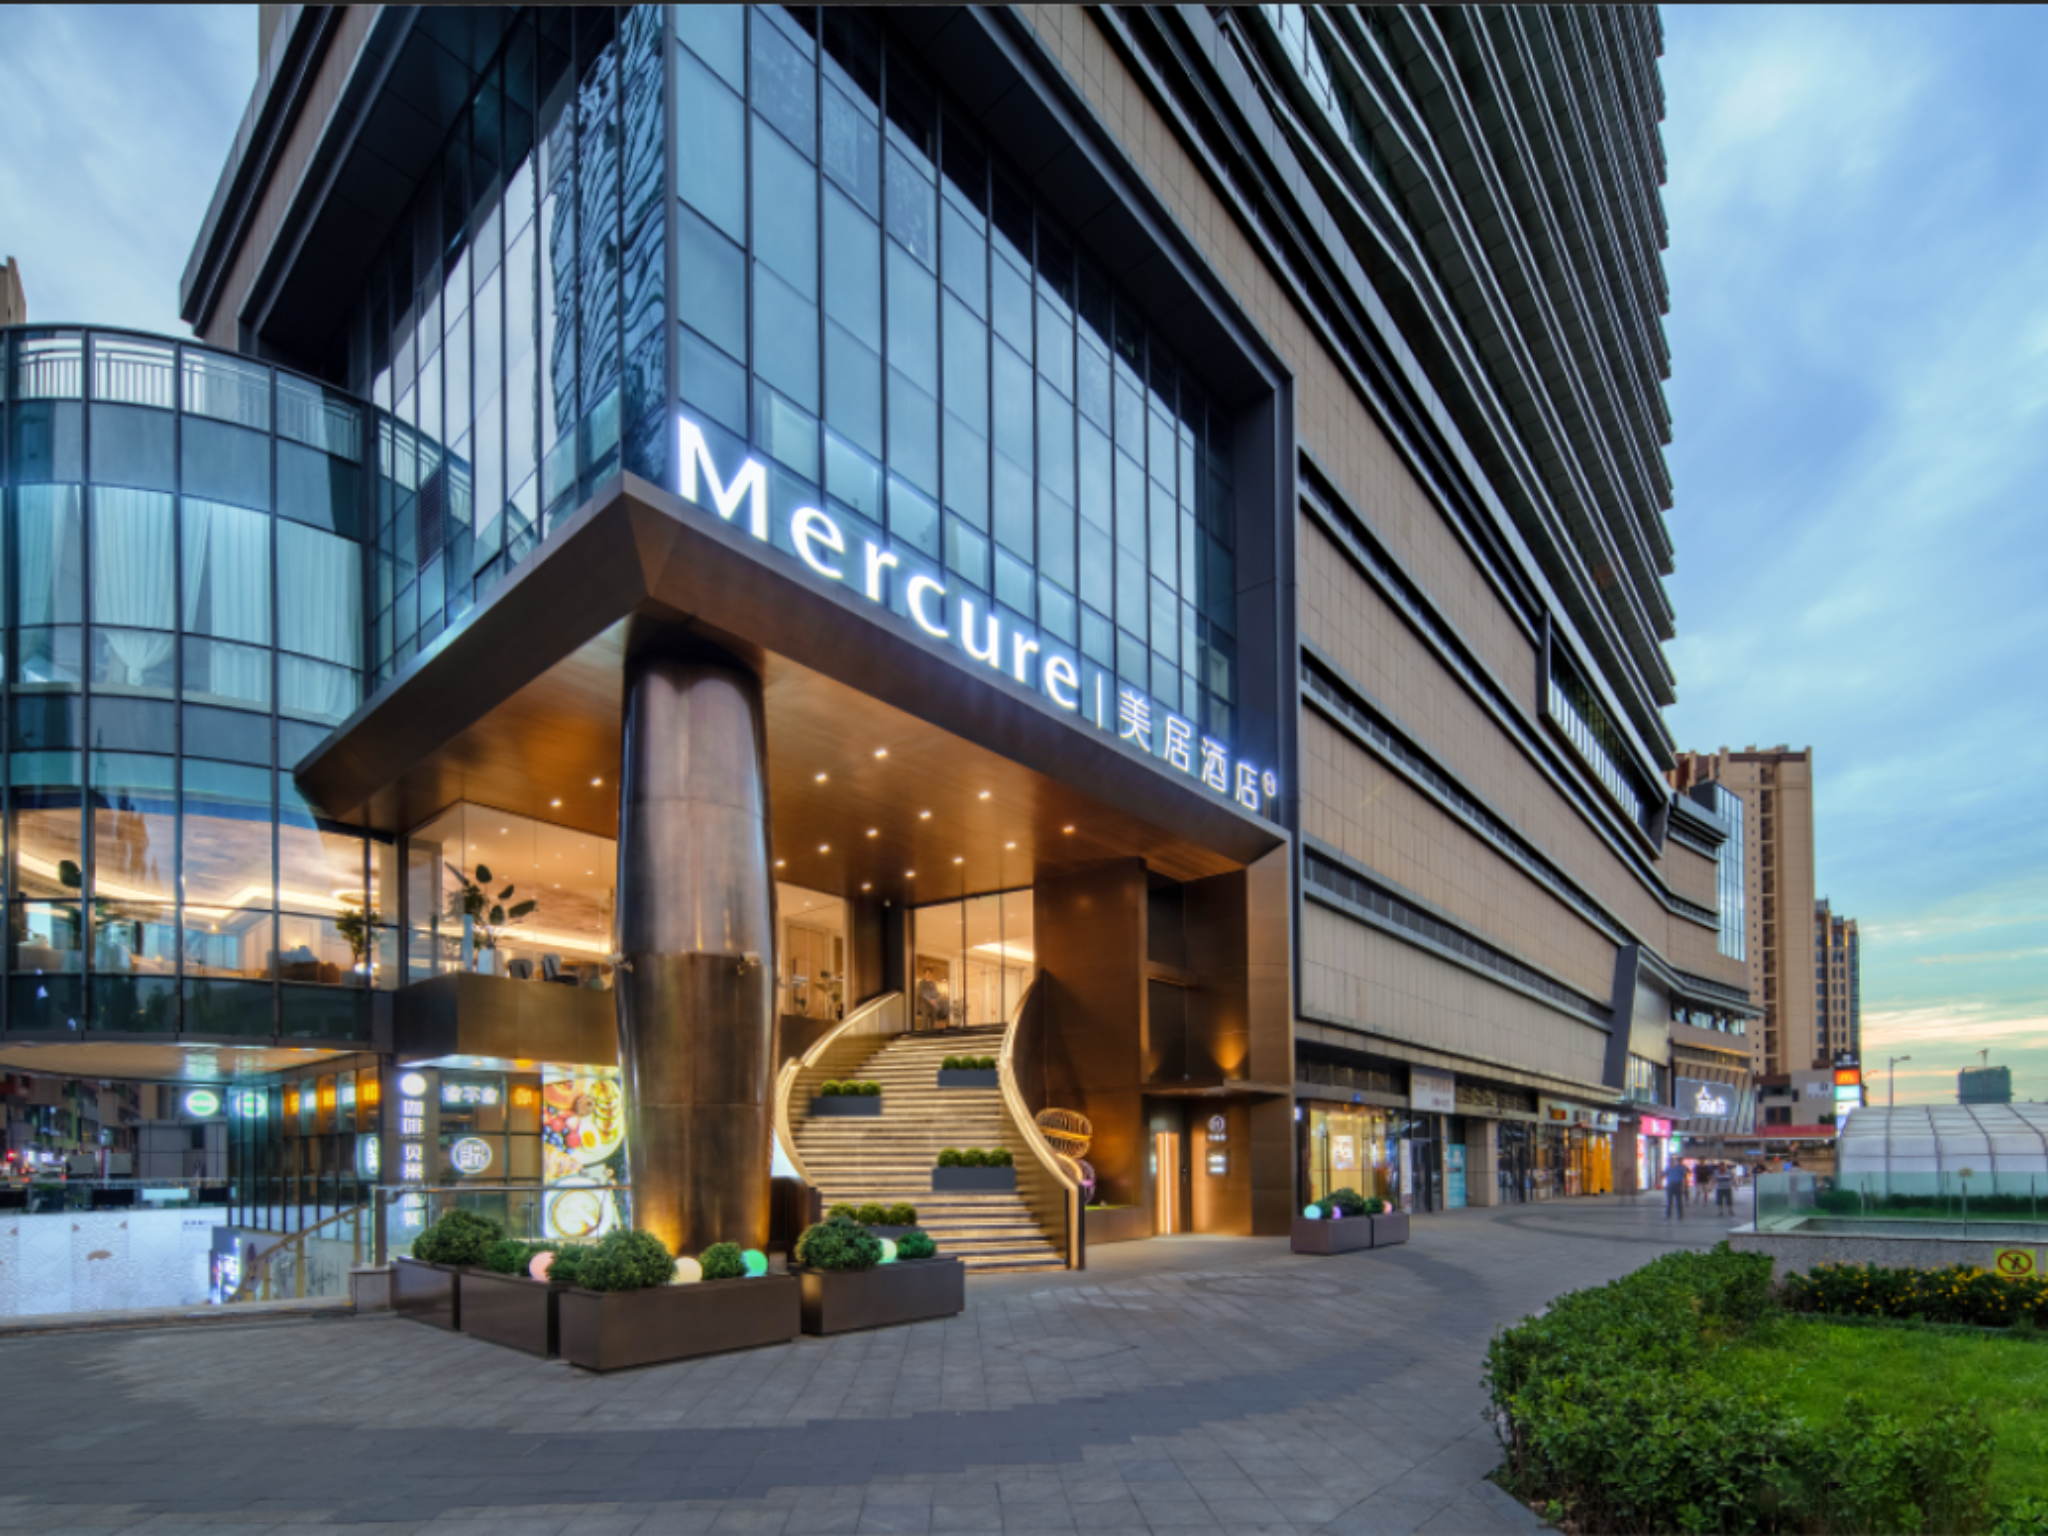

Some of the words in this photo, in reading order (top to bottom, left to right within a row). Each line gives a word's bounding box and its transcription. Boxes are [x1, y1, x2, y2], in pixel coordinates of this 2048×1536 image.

[677, 414, 1080, 711] Mercure
[1117, 688, 1259, 812] 美居酒店
